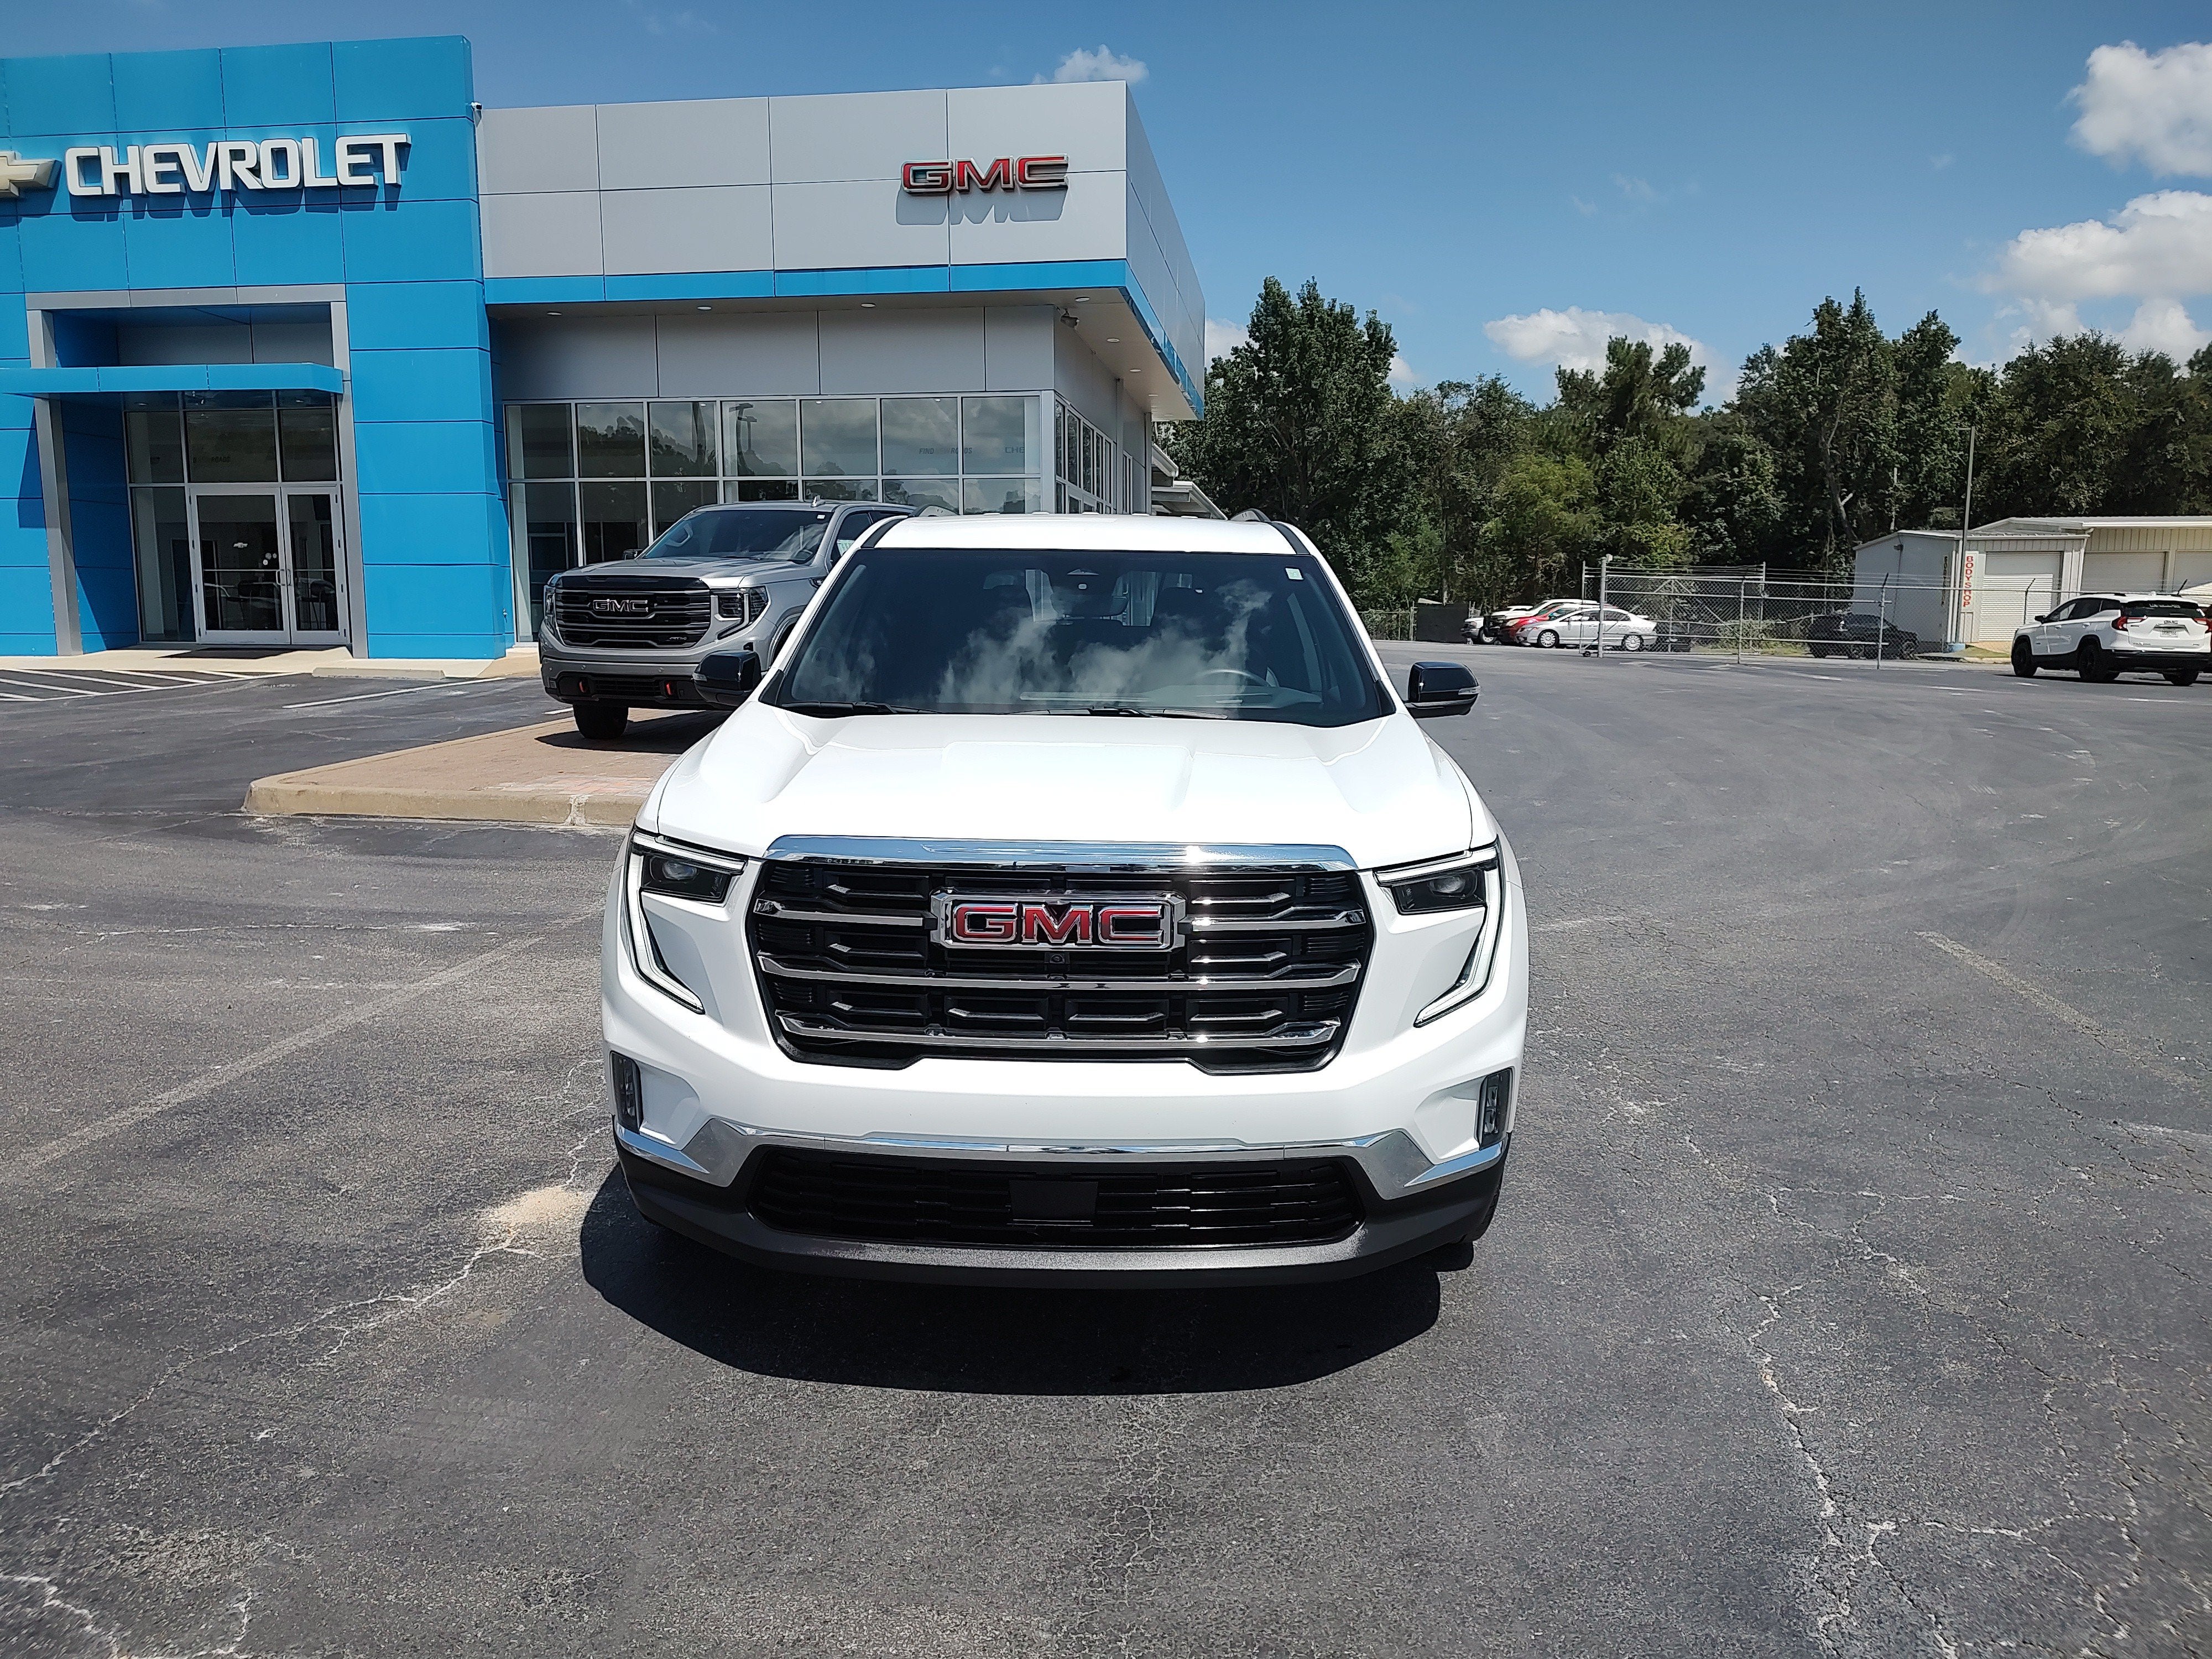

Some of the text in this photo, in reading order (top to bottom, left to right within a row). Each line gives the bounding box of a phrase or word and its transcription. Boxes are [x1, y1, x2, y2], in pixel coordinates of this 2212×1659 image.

[65, 133, 410, 196] CHEVROLET
[901, 153, 1068, 193] GMC
[593, 599, 648, 612] GMC
[953, 902, 1163, 944] GMC
